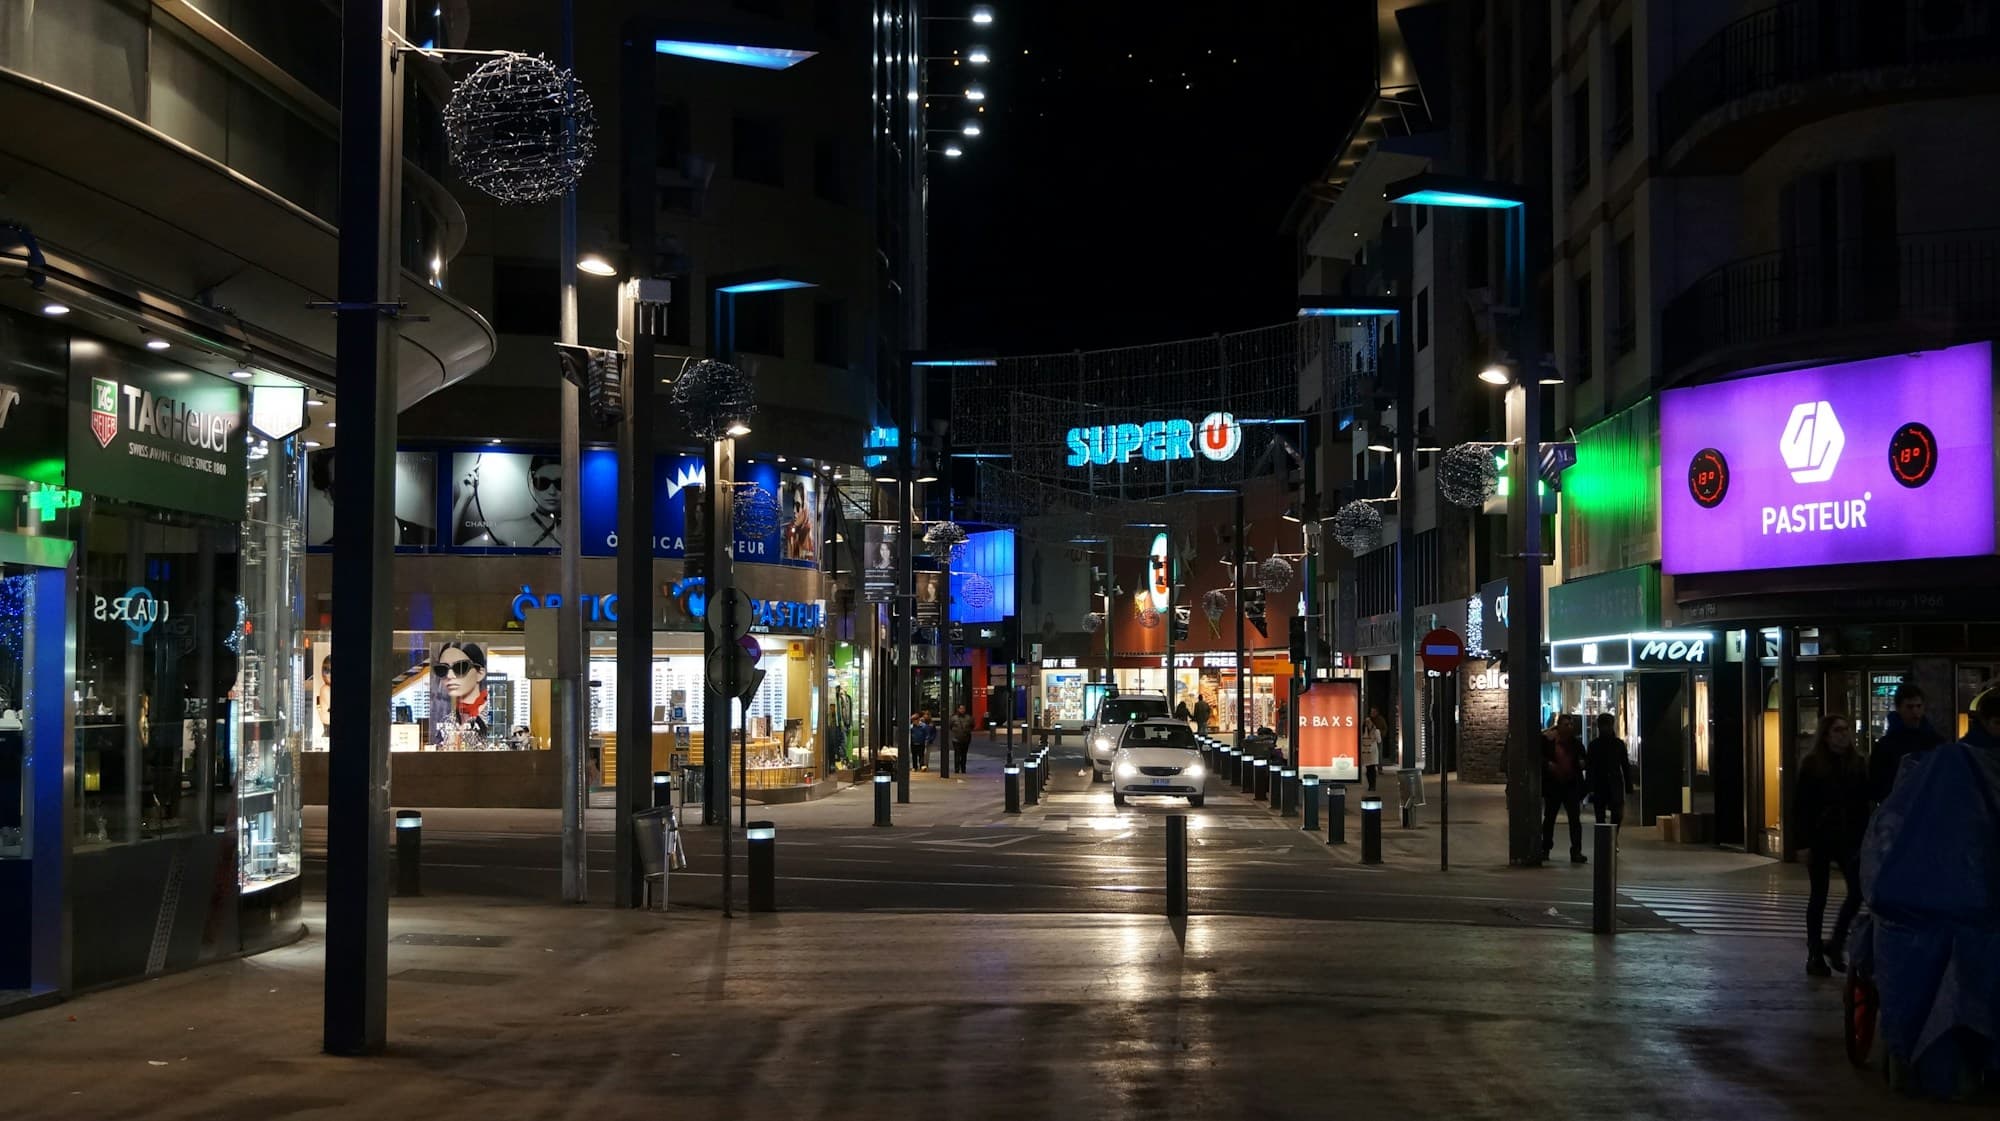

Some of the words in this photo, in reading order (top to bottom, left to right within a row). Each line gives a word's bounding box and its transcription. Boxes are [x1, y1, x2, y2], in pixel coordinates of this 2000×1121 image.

[96, 385, 114, 411] TAG
[128, 441, 149, 458] SWISS
[1066, 418, 1195, 467] SUPER
[465, 520, 498, 529] CHAN
[1761, 499, 1868, 535] PASTEUR
[1203, 656, 1238, 667] FREE
[1639, 638, 1706, 663] MOA
